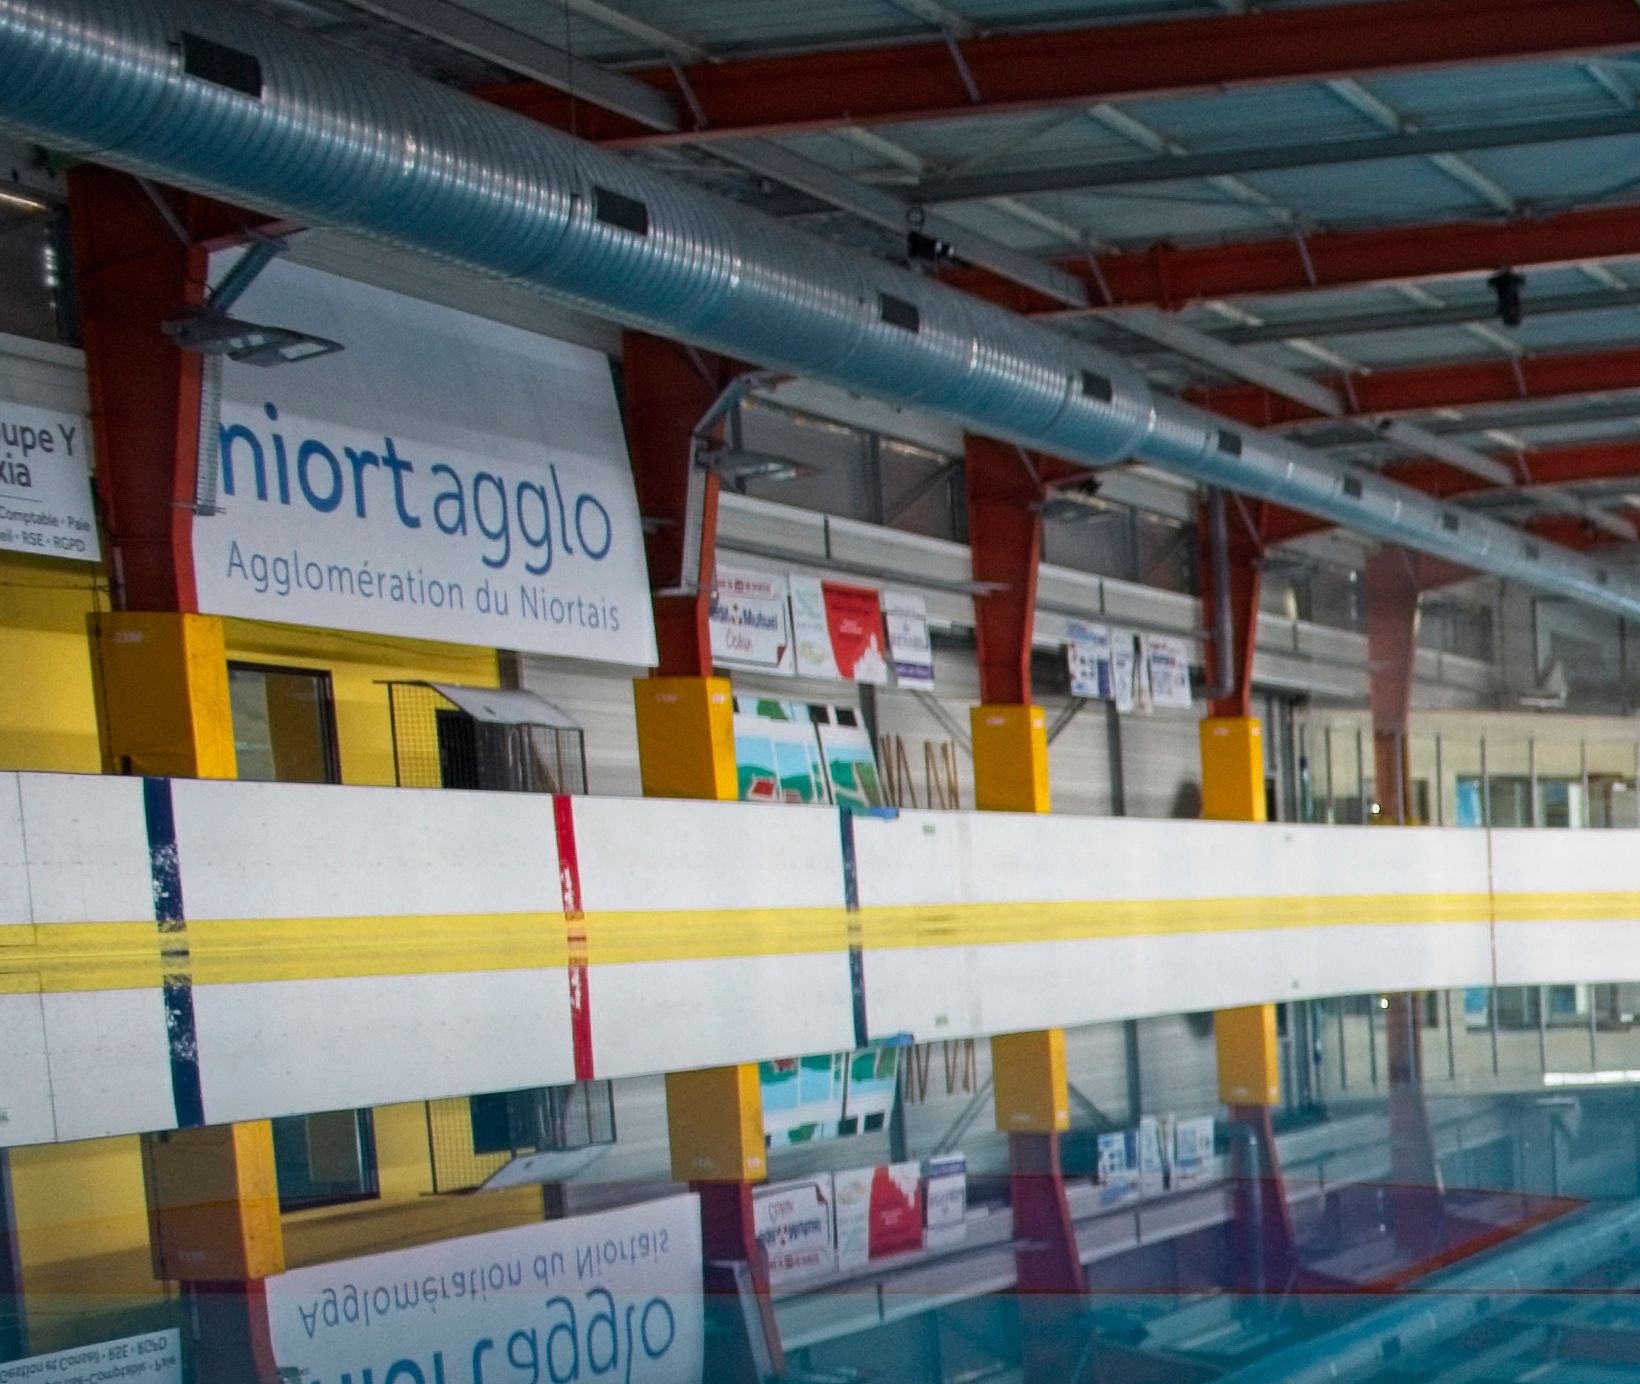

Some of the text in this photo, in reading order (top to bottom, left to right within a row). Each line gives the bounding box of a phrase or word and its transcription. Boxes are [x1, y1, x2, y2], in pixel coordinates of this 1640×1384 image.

[0, 422, 75, 458] upe Y
[227, 540, 620, 632] Agglomération du Niortais
